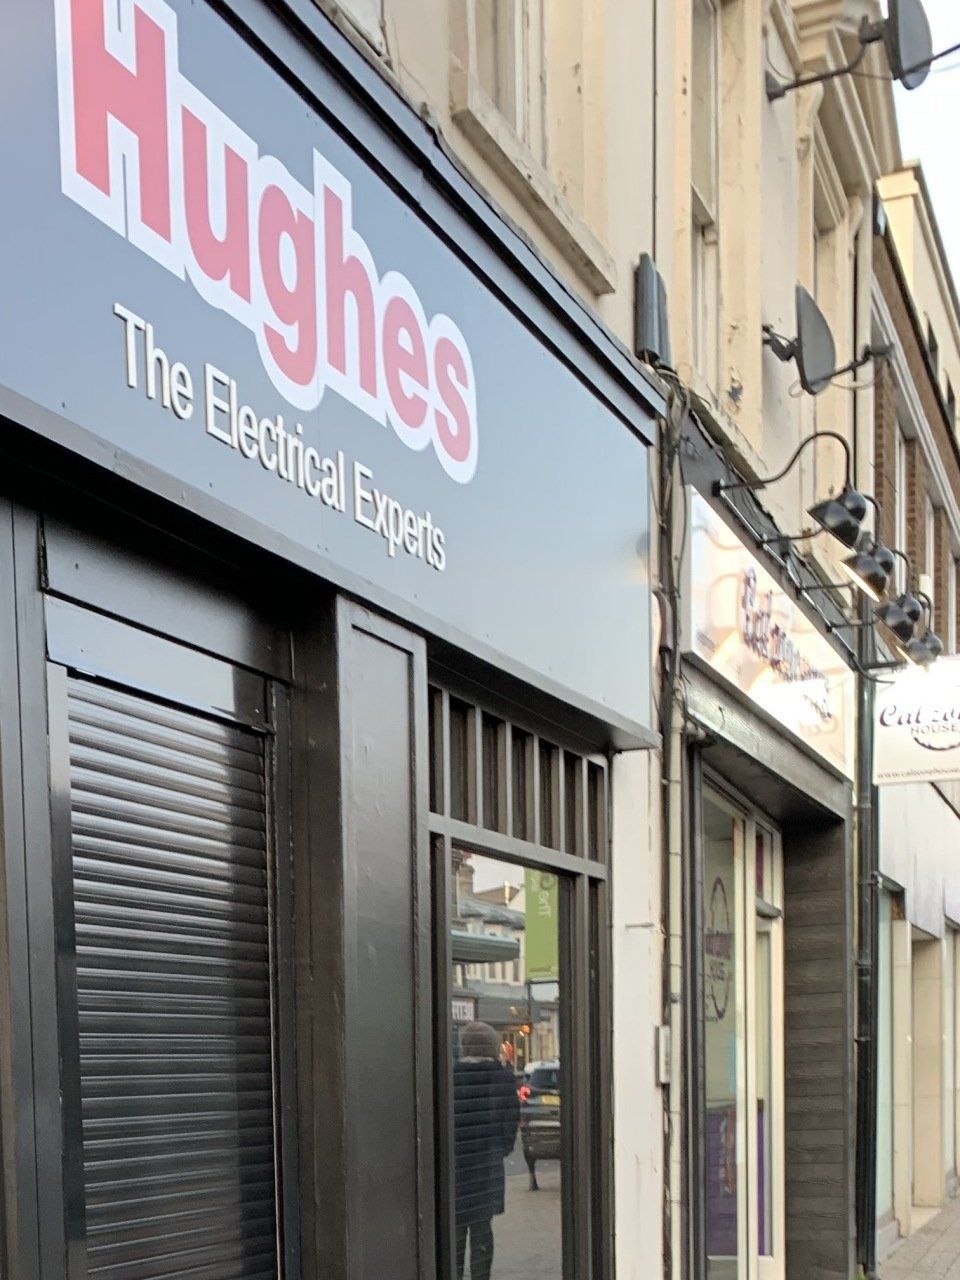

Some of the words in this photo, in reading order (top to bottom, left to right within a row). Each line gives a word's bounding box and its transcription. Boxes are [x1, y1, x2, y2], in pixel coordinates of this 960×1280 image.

[57, 0, 476, 478] Hughes
[113, 302, 193, 420] The
[204, 362, 345, 514] Electrical
[352, 460, 447, 572] Experts
